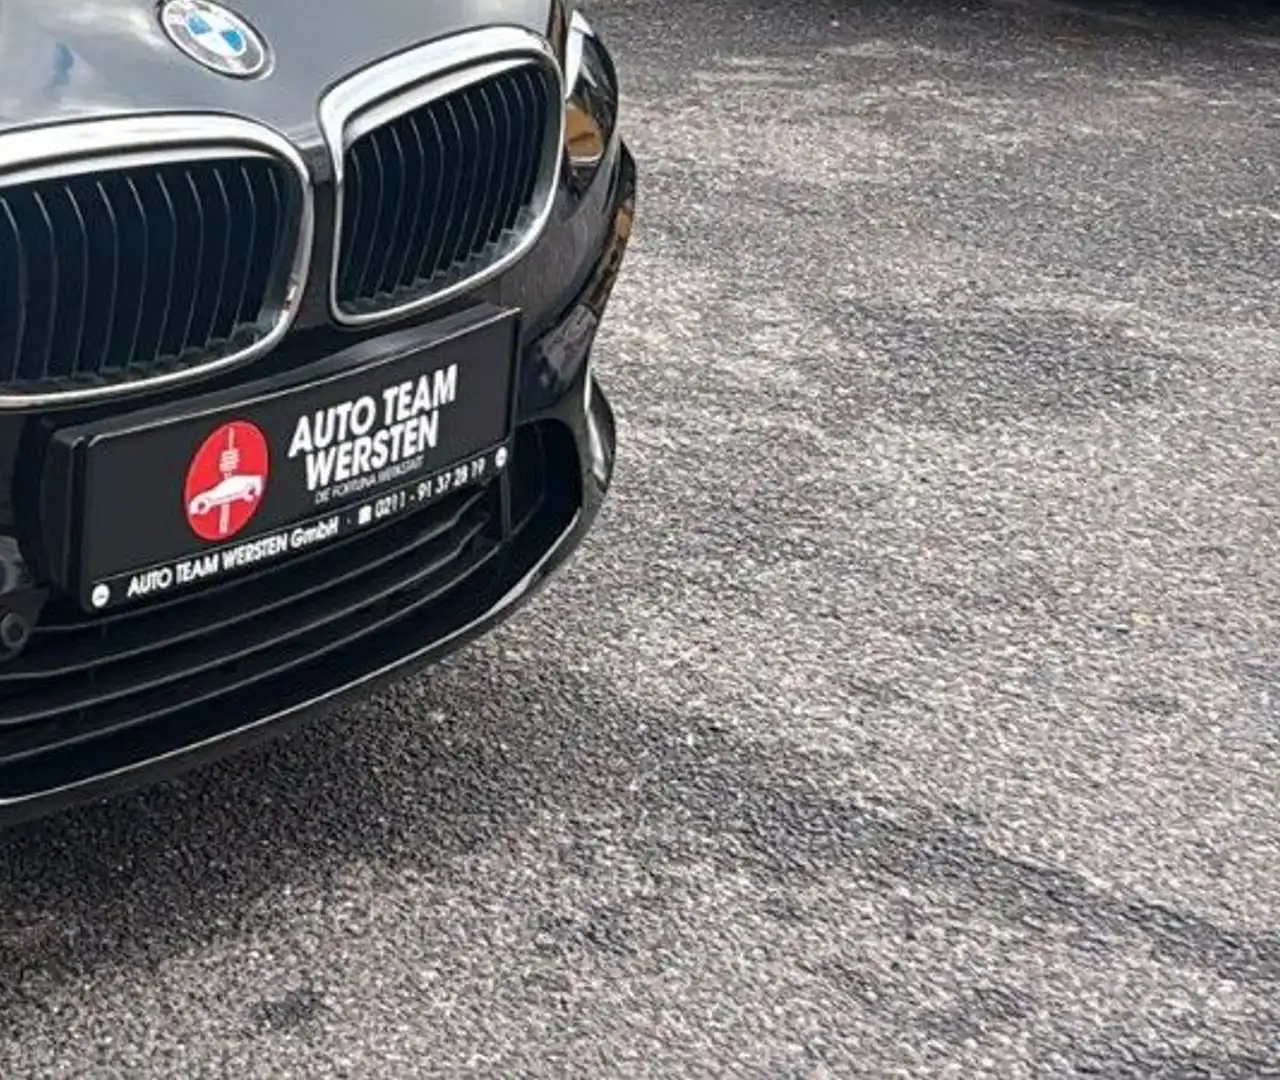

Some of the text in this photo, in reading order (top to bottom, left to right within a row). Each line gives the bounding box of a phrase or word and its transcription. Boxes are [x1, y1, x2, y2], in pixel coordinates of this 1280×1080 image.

[287, 363, 458, 459] AUTO TEAM
[305, 409, 440, 492] WERSTEN
[126, 567, 173, 598] AUTO
[175, 554, 220, 584] TEAM
[221, 532, 289, 571] WERSTEN
[290, 515, 340, 548] GmbH
